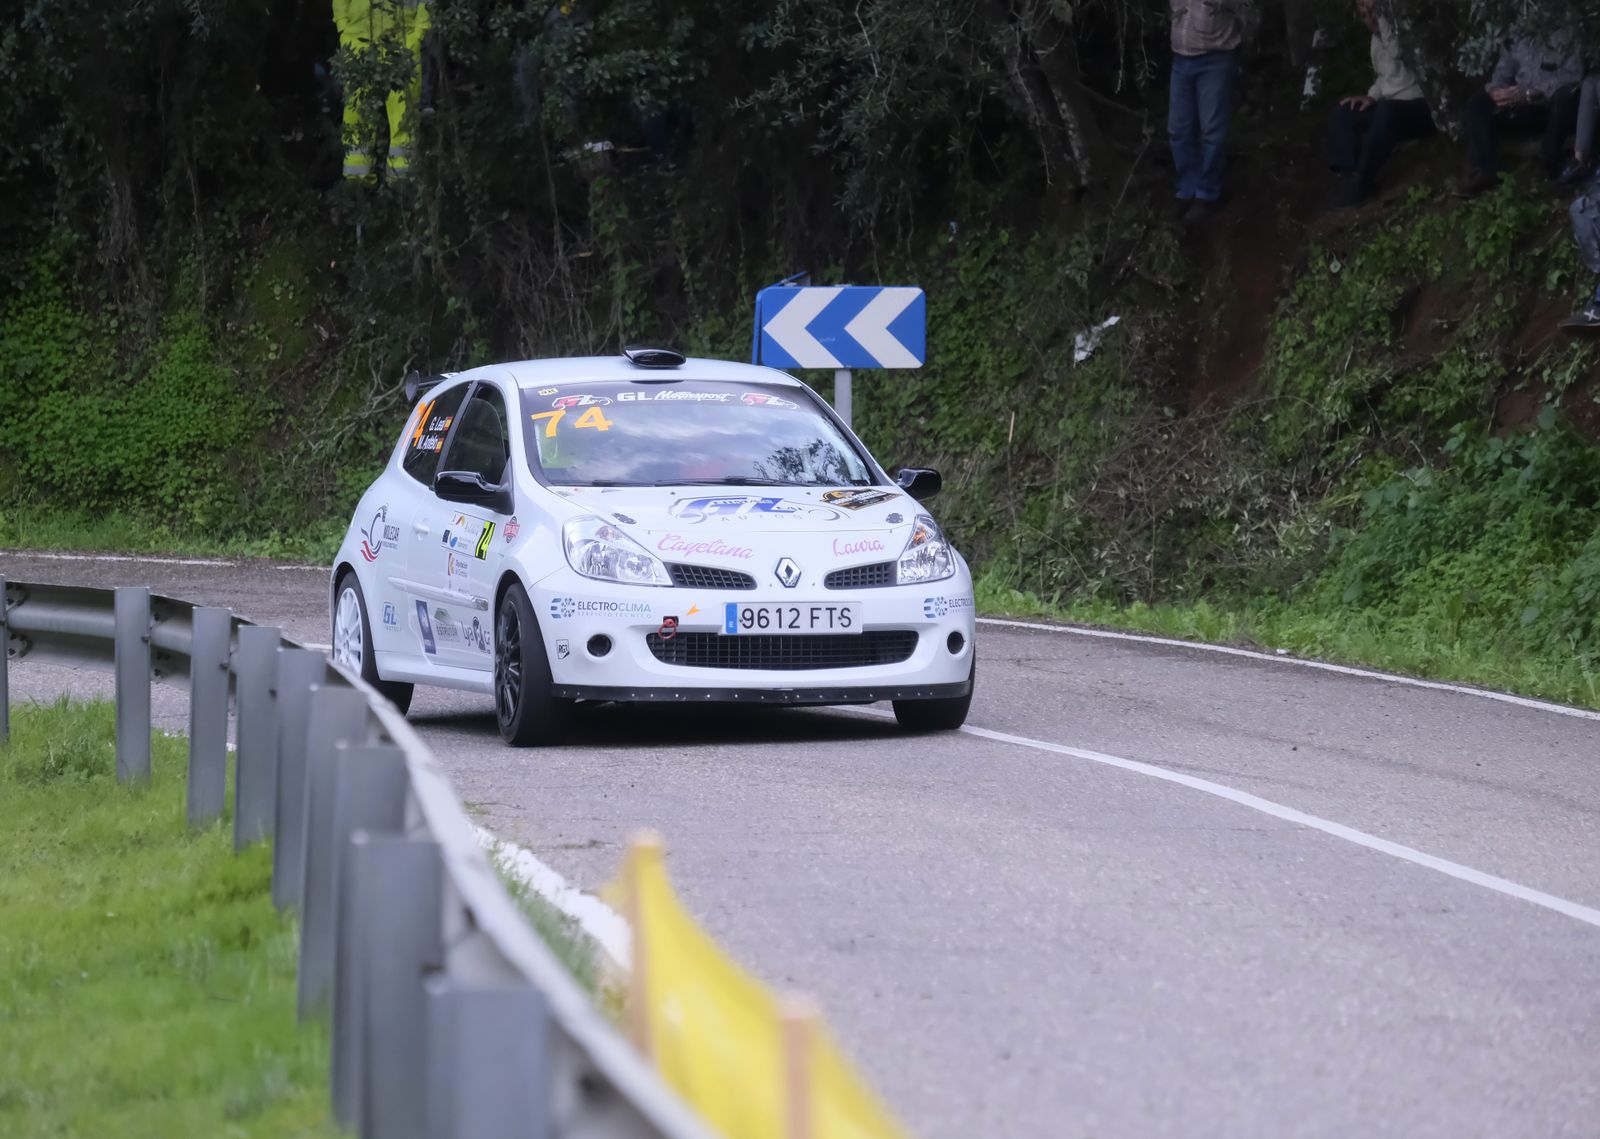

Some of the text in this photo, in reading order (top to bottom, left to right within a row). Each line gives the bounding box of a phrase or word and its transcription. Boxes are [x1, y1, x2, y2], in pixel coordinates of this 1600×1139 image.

[617, 390, 737, 402] GL Motorsport
[531, 406, 614, 438] 74
[657, 533, 755, 559] Cayetana
[833, 538, 885, 557] Laura
[741, 607, 853, 629] 9612 FTS
